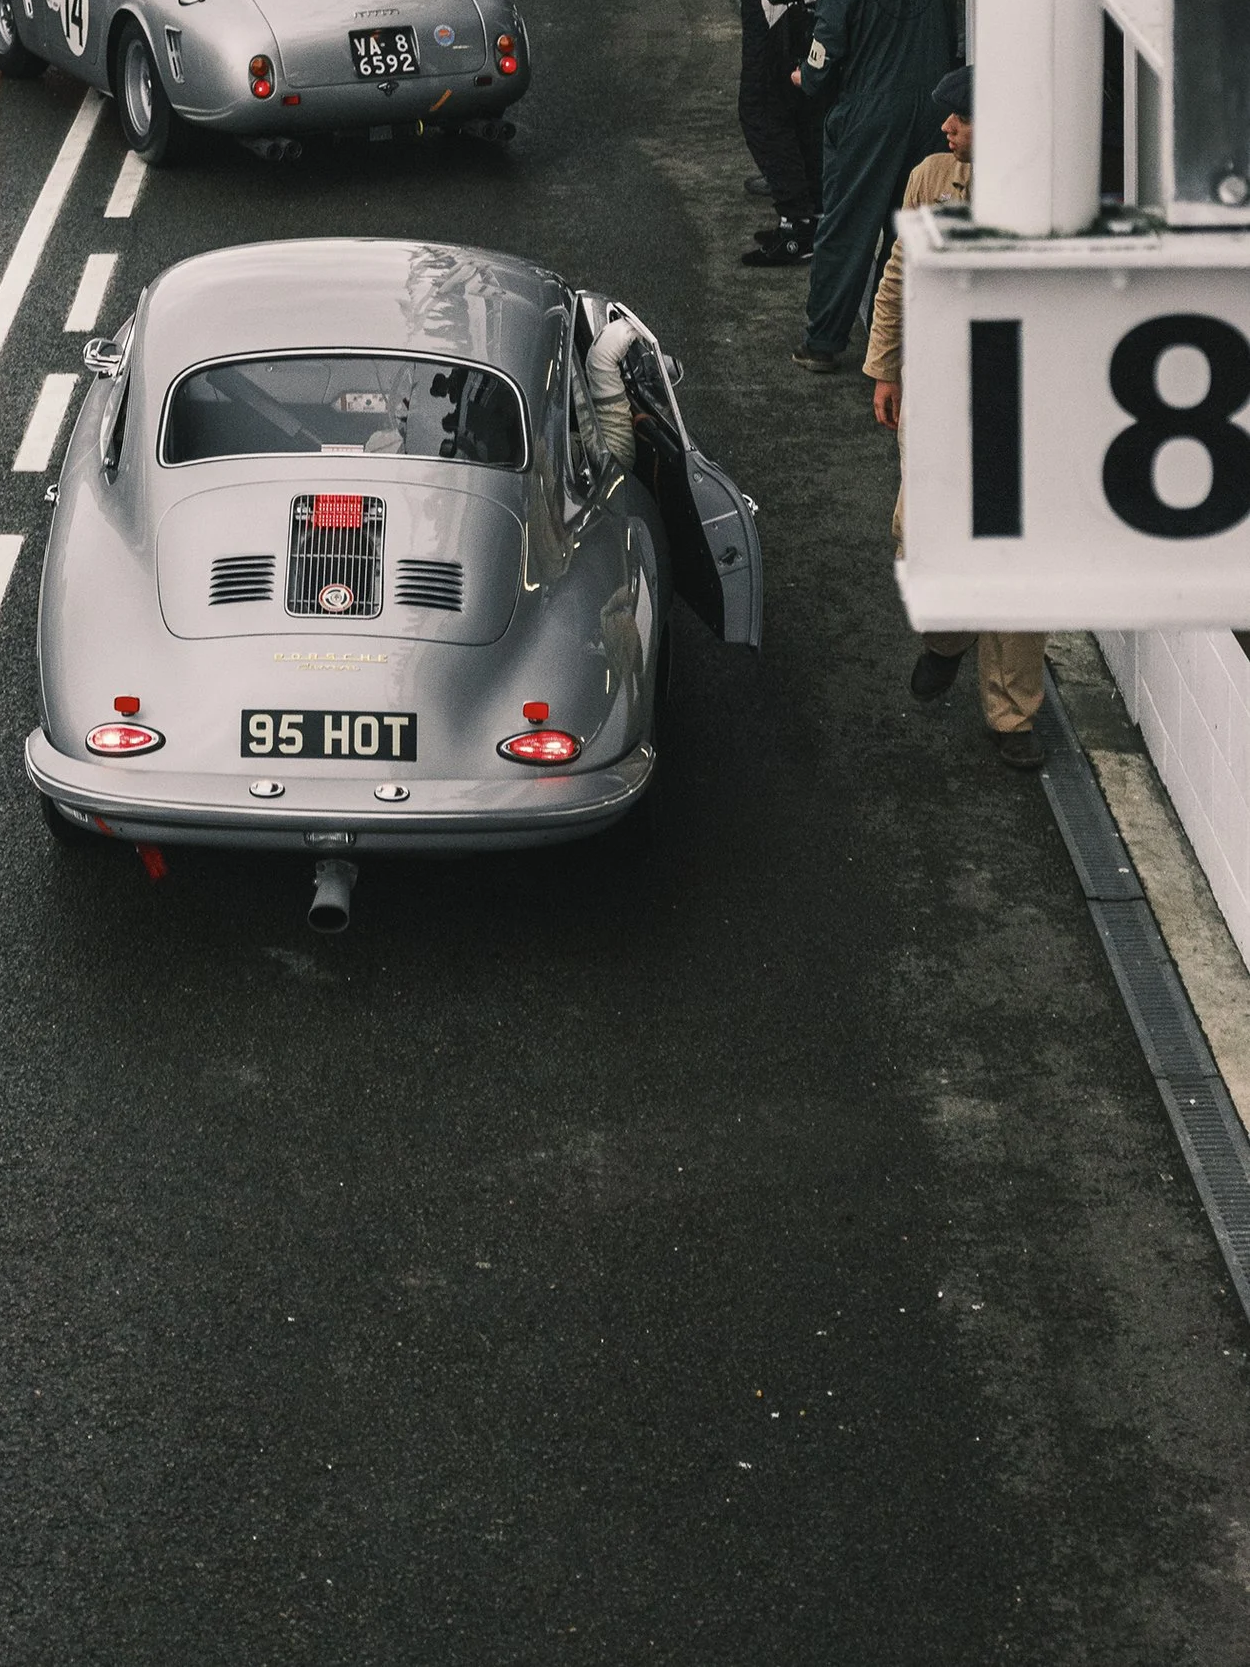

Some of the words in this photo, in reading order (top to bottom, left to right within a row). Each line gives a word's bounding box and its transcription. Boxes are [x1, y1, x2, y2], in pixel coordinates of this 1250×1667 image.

[395, 34, 409, 52] 8
[359, 53, 415, 75] 6592
[969, 313, 1250, 540] 18
[274, 653, 388, 664] PORSCHE
[249, 713, 303, 754] 95
[324, 714, 409, 757] HOT
